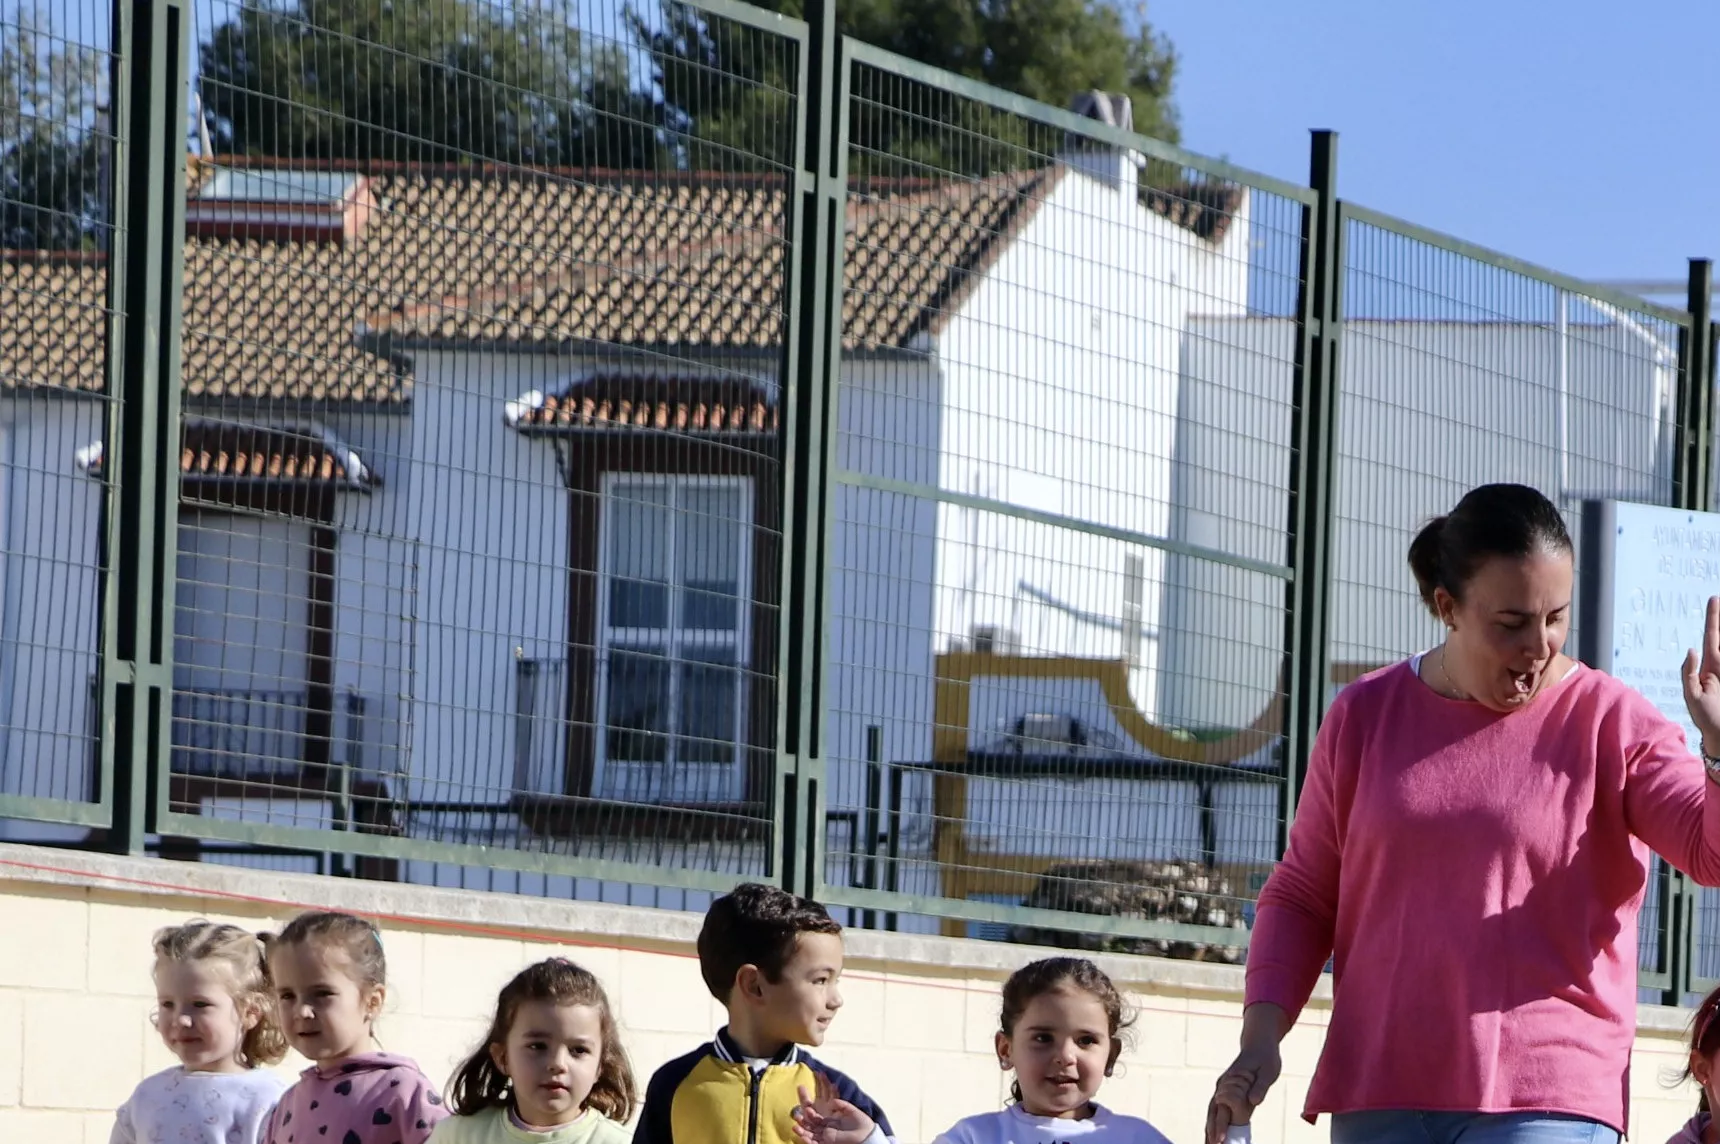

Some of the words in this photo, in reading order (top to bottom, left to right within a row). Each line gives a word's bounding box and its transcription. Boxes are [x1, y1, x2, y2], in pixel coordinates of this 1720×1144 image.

[1659, 554, 1673, 578] DE
[1679, 558, 1720, 581] LUCENA
[1622, 621, 1644, 649] EN
[1658, 625, 1680, 654] LA
